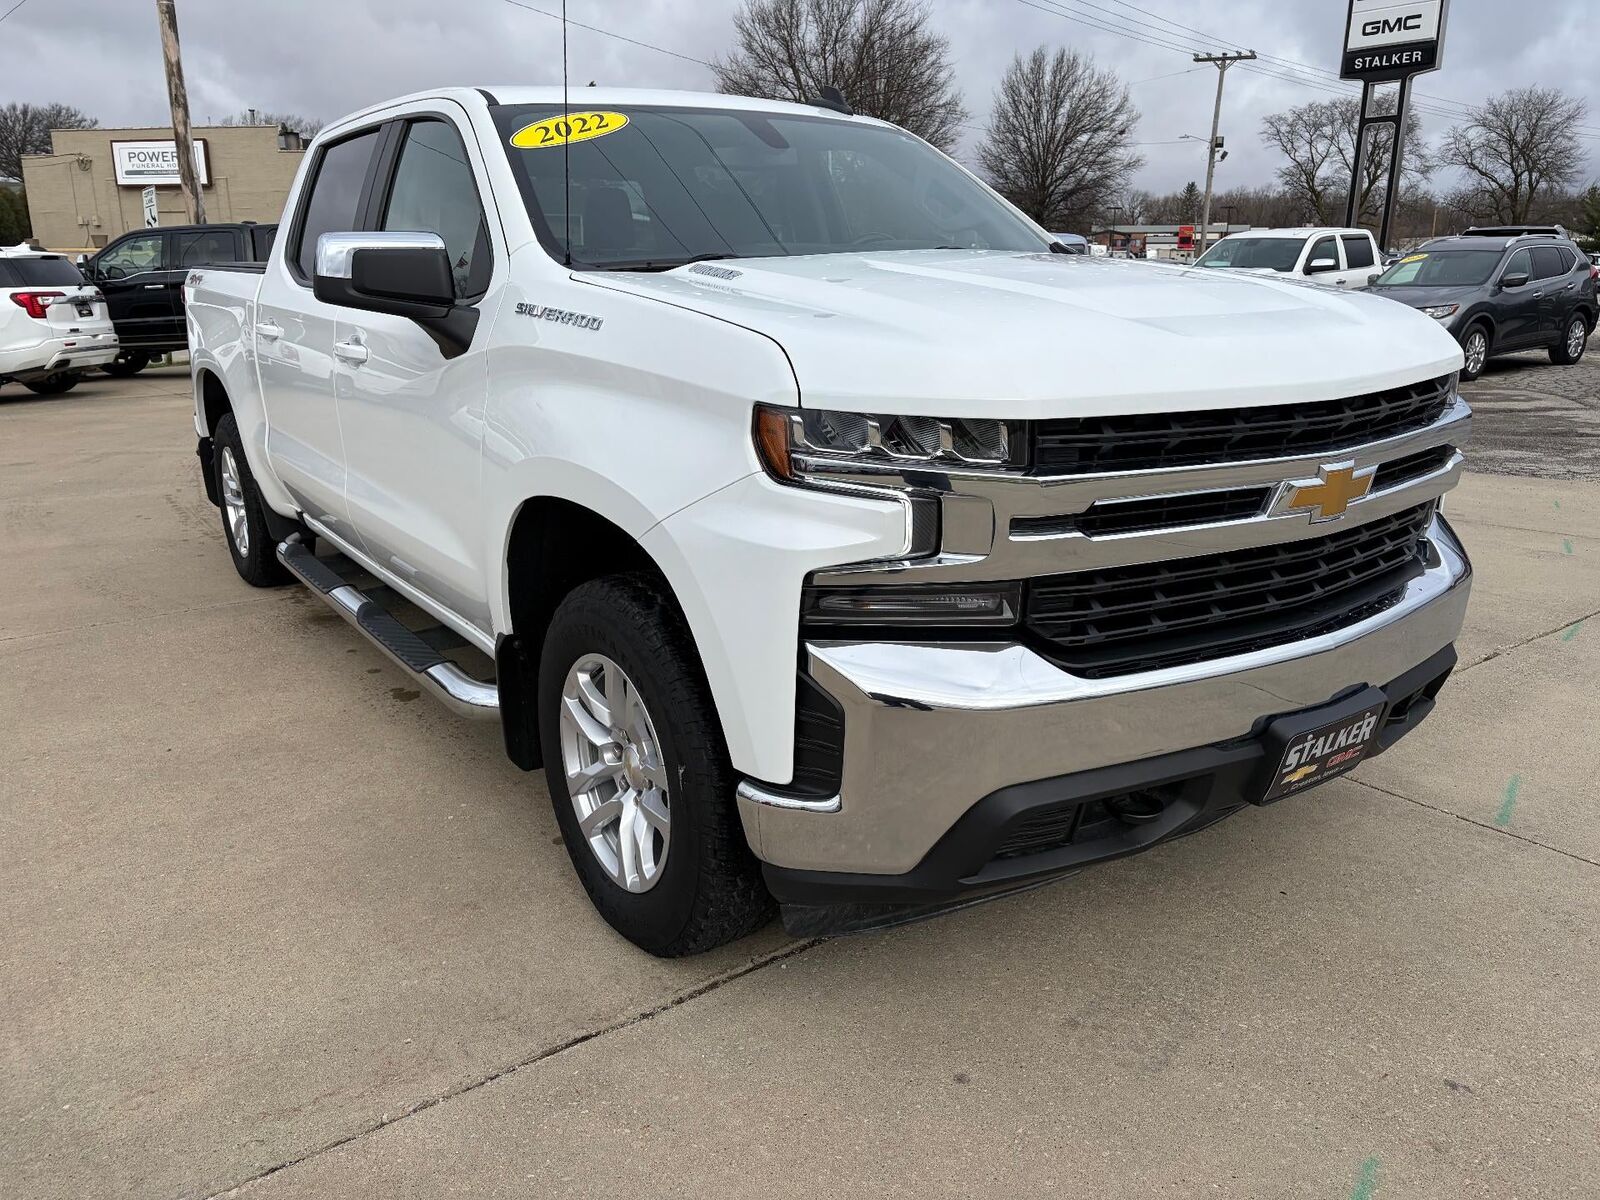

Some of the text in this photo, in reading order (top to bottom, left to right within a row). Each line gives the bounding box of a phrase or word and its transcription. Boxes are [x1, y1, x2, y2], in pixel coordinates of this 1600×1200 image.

[1362, 14, 1422, 36] GMC
[1354, 51, 1422, 69] STALKER
[534, 113, 609, 144] 2022
[128, 151, 178, 163] POWER
[515, 302, 604, 331] SILVERADO
[1282, 712, 1377, 774] STALKER
